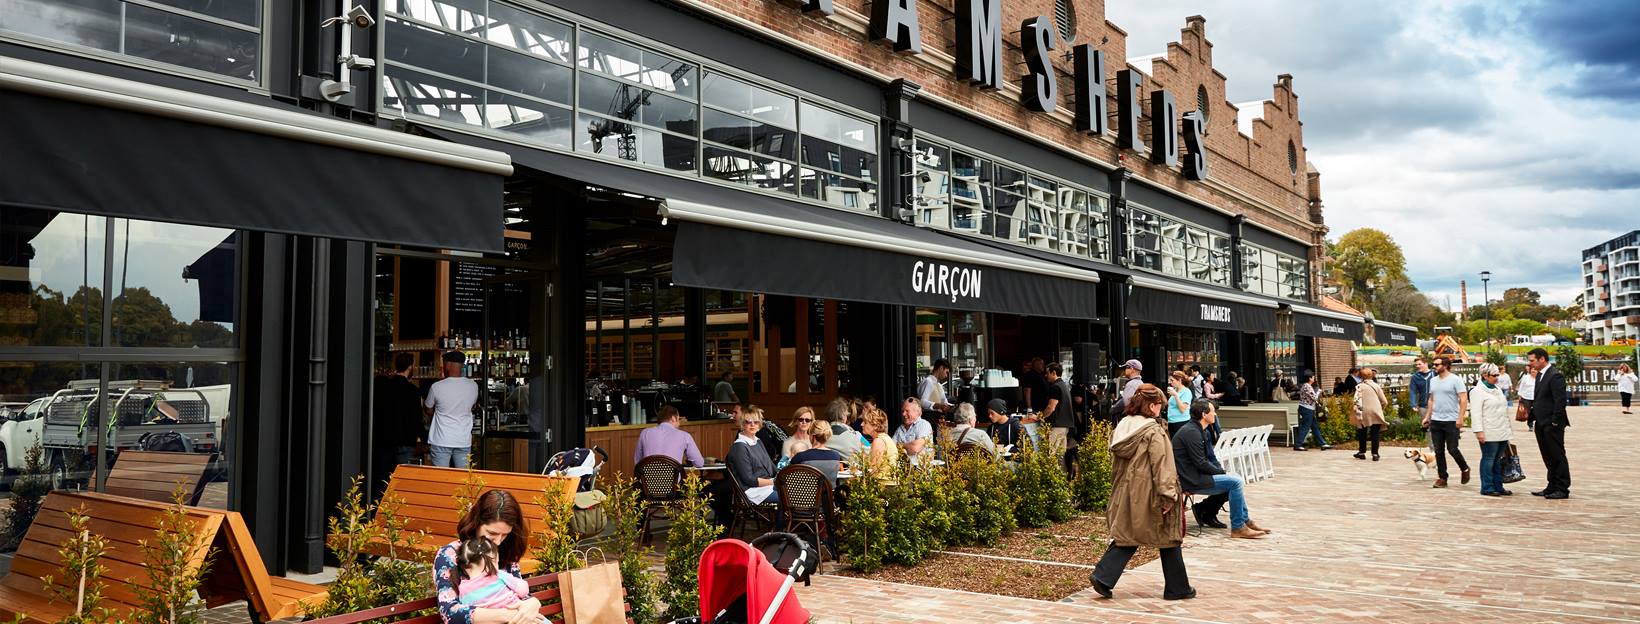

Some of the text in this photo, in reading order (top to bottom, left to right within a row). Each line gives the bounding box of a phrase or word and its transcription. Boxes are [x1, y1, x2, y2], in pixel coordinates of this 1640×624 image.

[778, 0, 1208, 181] AMSHEDS
[507, 241, 528, 250] GARÇON
[911, 260, 982, 303] GARÇON
[1200, 303, 1231, 323] TRAMSHEDS
[1603, 369, 1617, 381] PA
[1603, 384, 1618, 392] BACK
